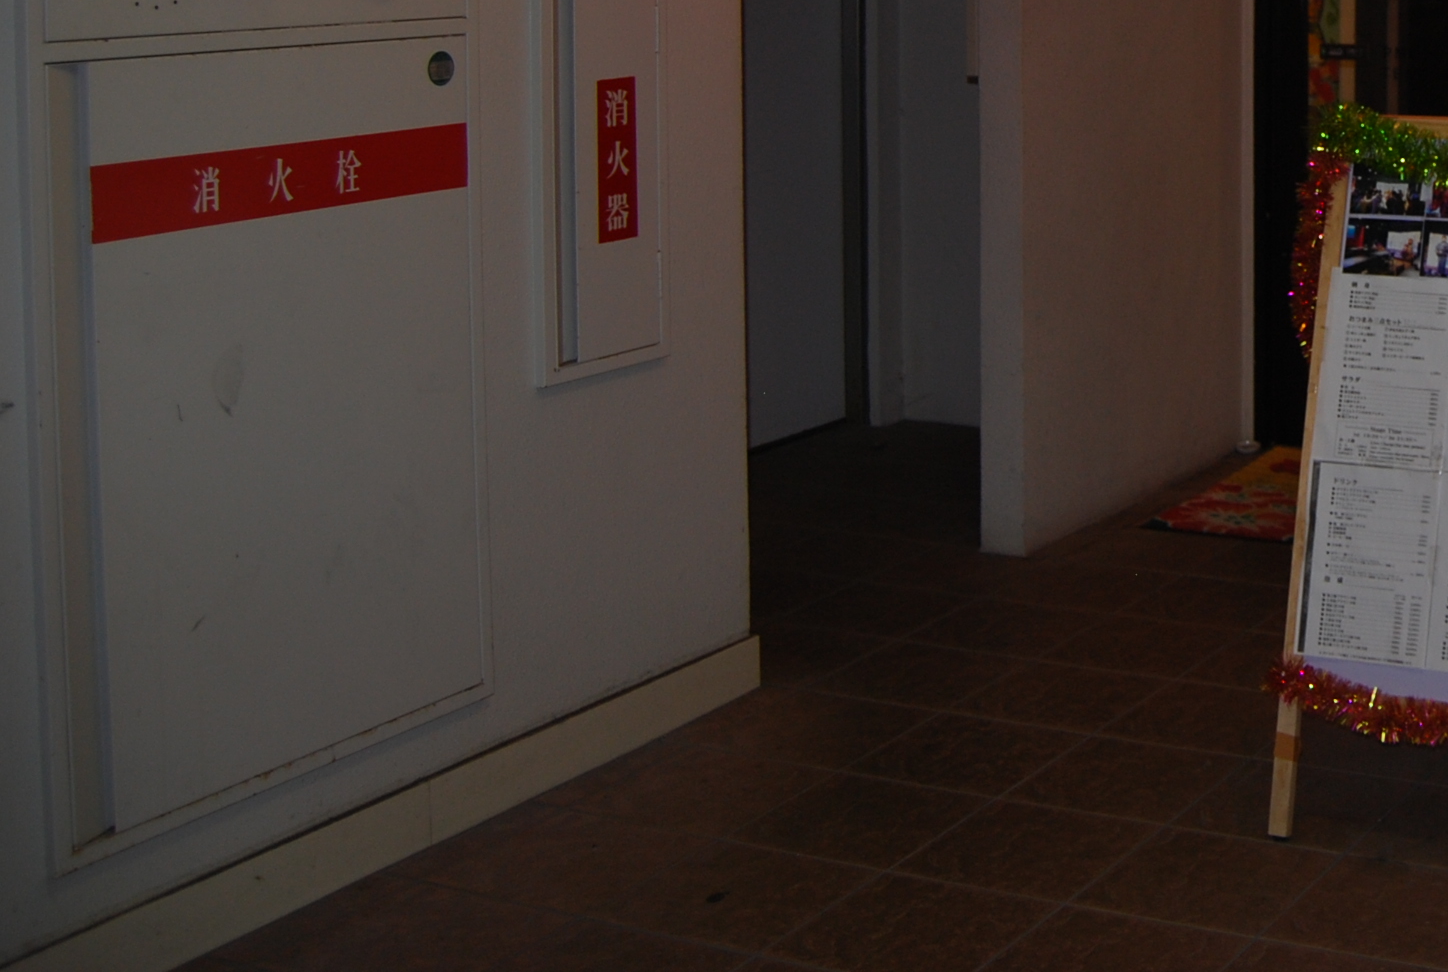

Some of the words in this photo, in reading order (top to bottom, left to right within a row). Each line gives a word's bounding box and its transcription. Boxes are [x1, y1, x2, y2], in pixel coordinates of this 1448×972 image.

[191, 149, 362, 215] 消火栓
[604, 88, 630, 233] 消火器
